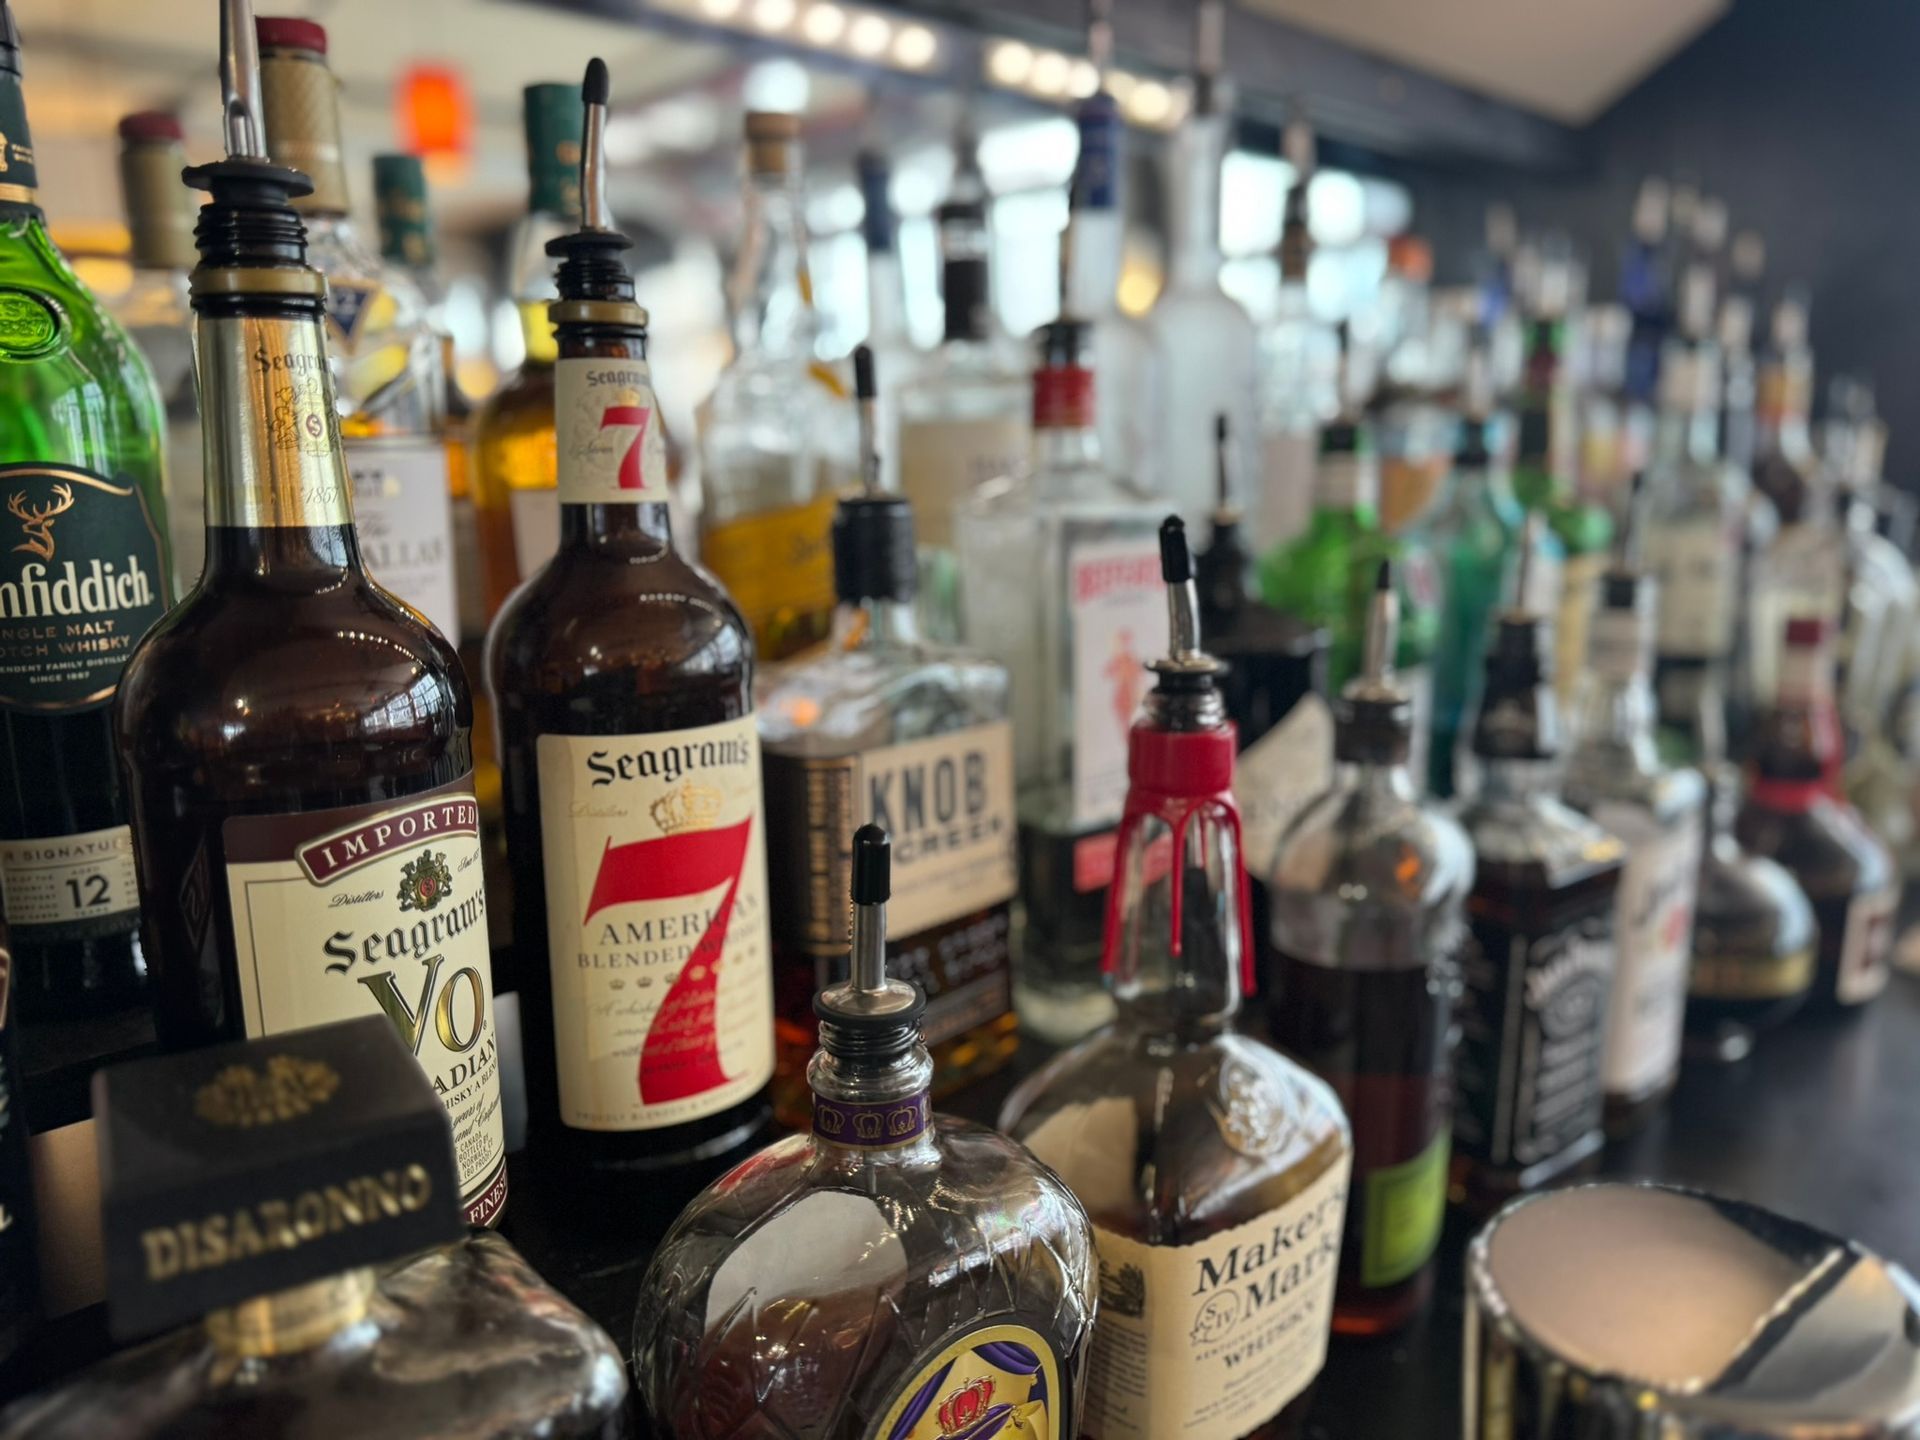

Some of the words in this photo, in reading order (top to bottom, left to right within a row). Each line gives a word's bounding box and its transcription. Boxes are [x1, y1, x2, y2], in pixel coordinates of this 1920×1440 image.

[599, 404, 652, 490] 7
[305, 486, 339, 504] 1857
[66, 619, 116, 637] MALT
[59, 635, 131, 654] WHISKY
[30, 676, 63, 684] SINCE
[46, 659, 84, 671] FAMILY
[586, 733, 751, 788] Seagram's
[869, 750, 988, 838] KNOB
[321, 804, 475, 869] IMPORTED
[65, 873, 112, 910] 12
[328, 890, 384, 909] Distillers
[323, 887, 486, 977] Seagram's
[577, 944, 693, 970] BLENDED
[581, 809, 754, 1107] 7
[459, 1140, 482, 1162] BOTTLED
[460, 1131, 482, 1153] CANADA
[141, 1162, 432, 1282] DISARONNO
[1241, 1231, 1336, 1320] Mark
